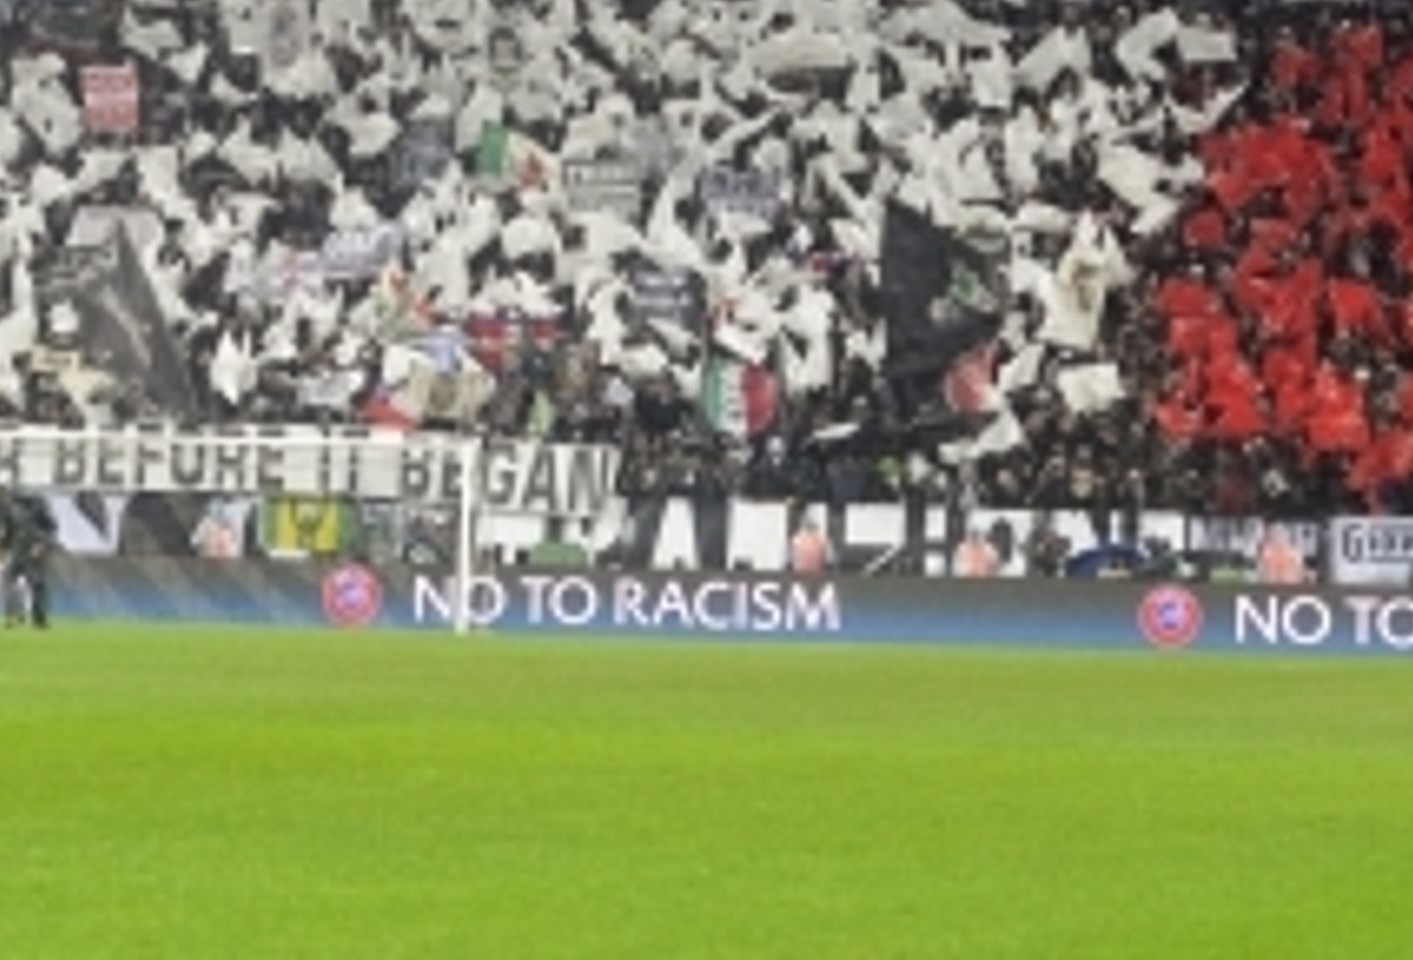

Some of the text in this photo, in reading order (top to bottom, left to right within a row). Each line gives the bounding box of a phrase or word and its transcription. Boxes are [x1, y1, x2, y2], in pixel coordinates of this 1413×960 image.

[414, 575, 842, 631] NO TO RACISM
[1234, 594, 1331, 644] NO
